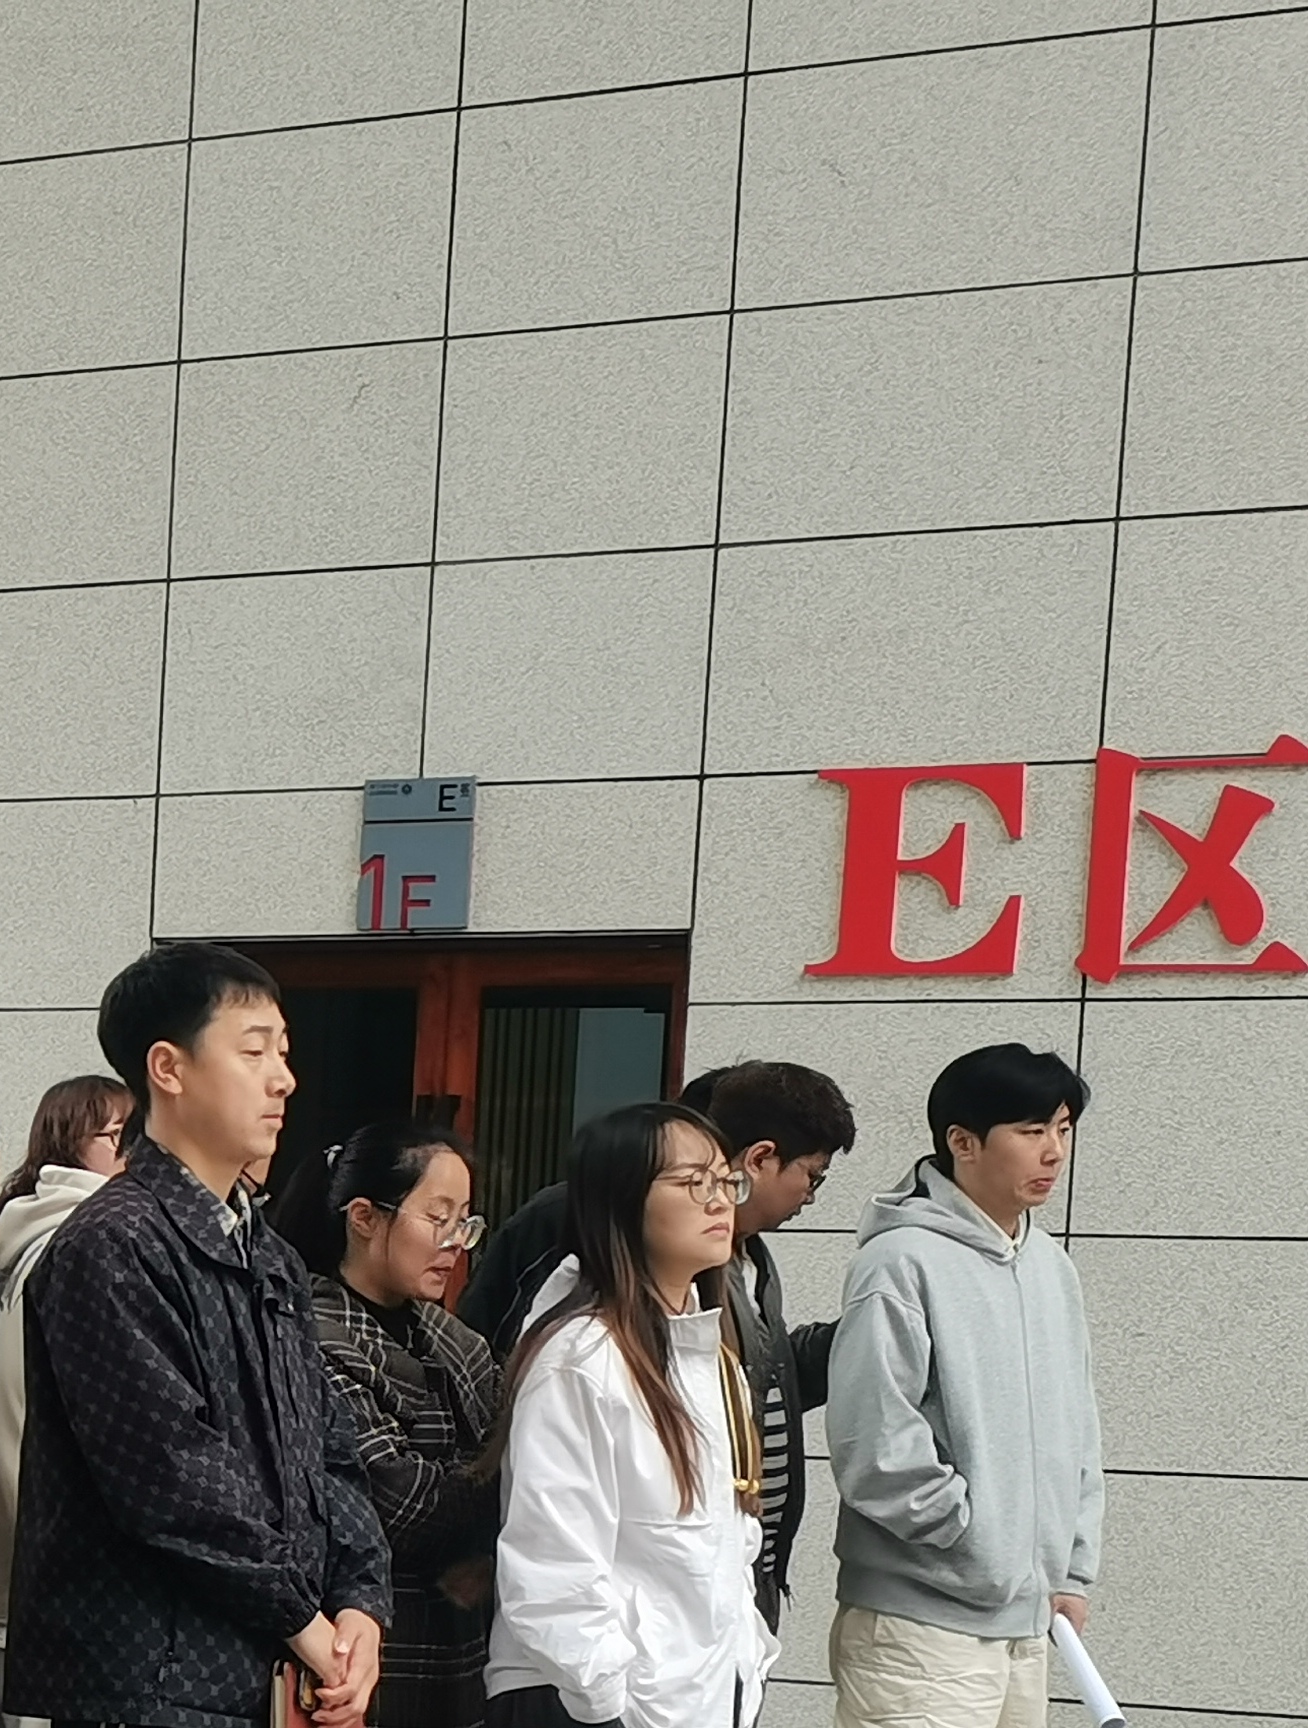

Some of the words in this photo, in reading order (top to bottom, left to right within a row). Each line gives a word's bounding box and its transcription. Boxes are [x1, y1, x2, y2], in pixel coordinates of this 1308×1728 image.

[438, 784, 458, 811] E
[361, 854, 436, 930] 1F
[804, 734, 1308, 984] E区
